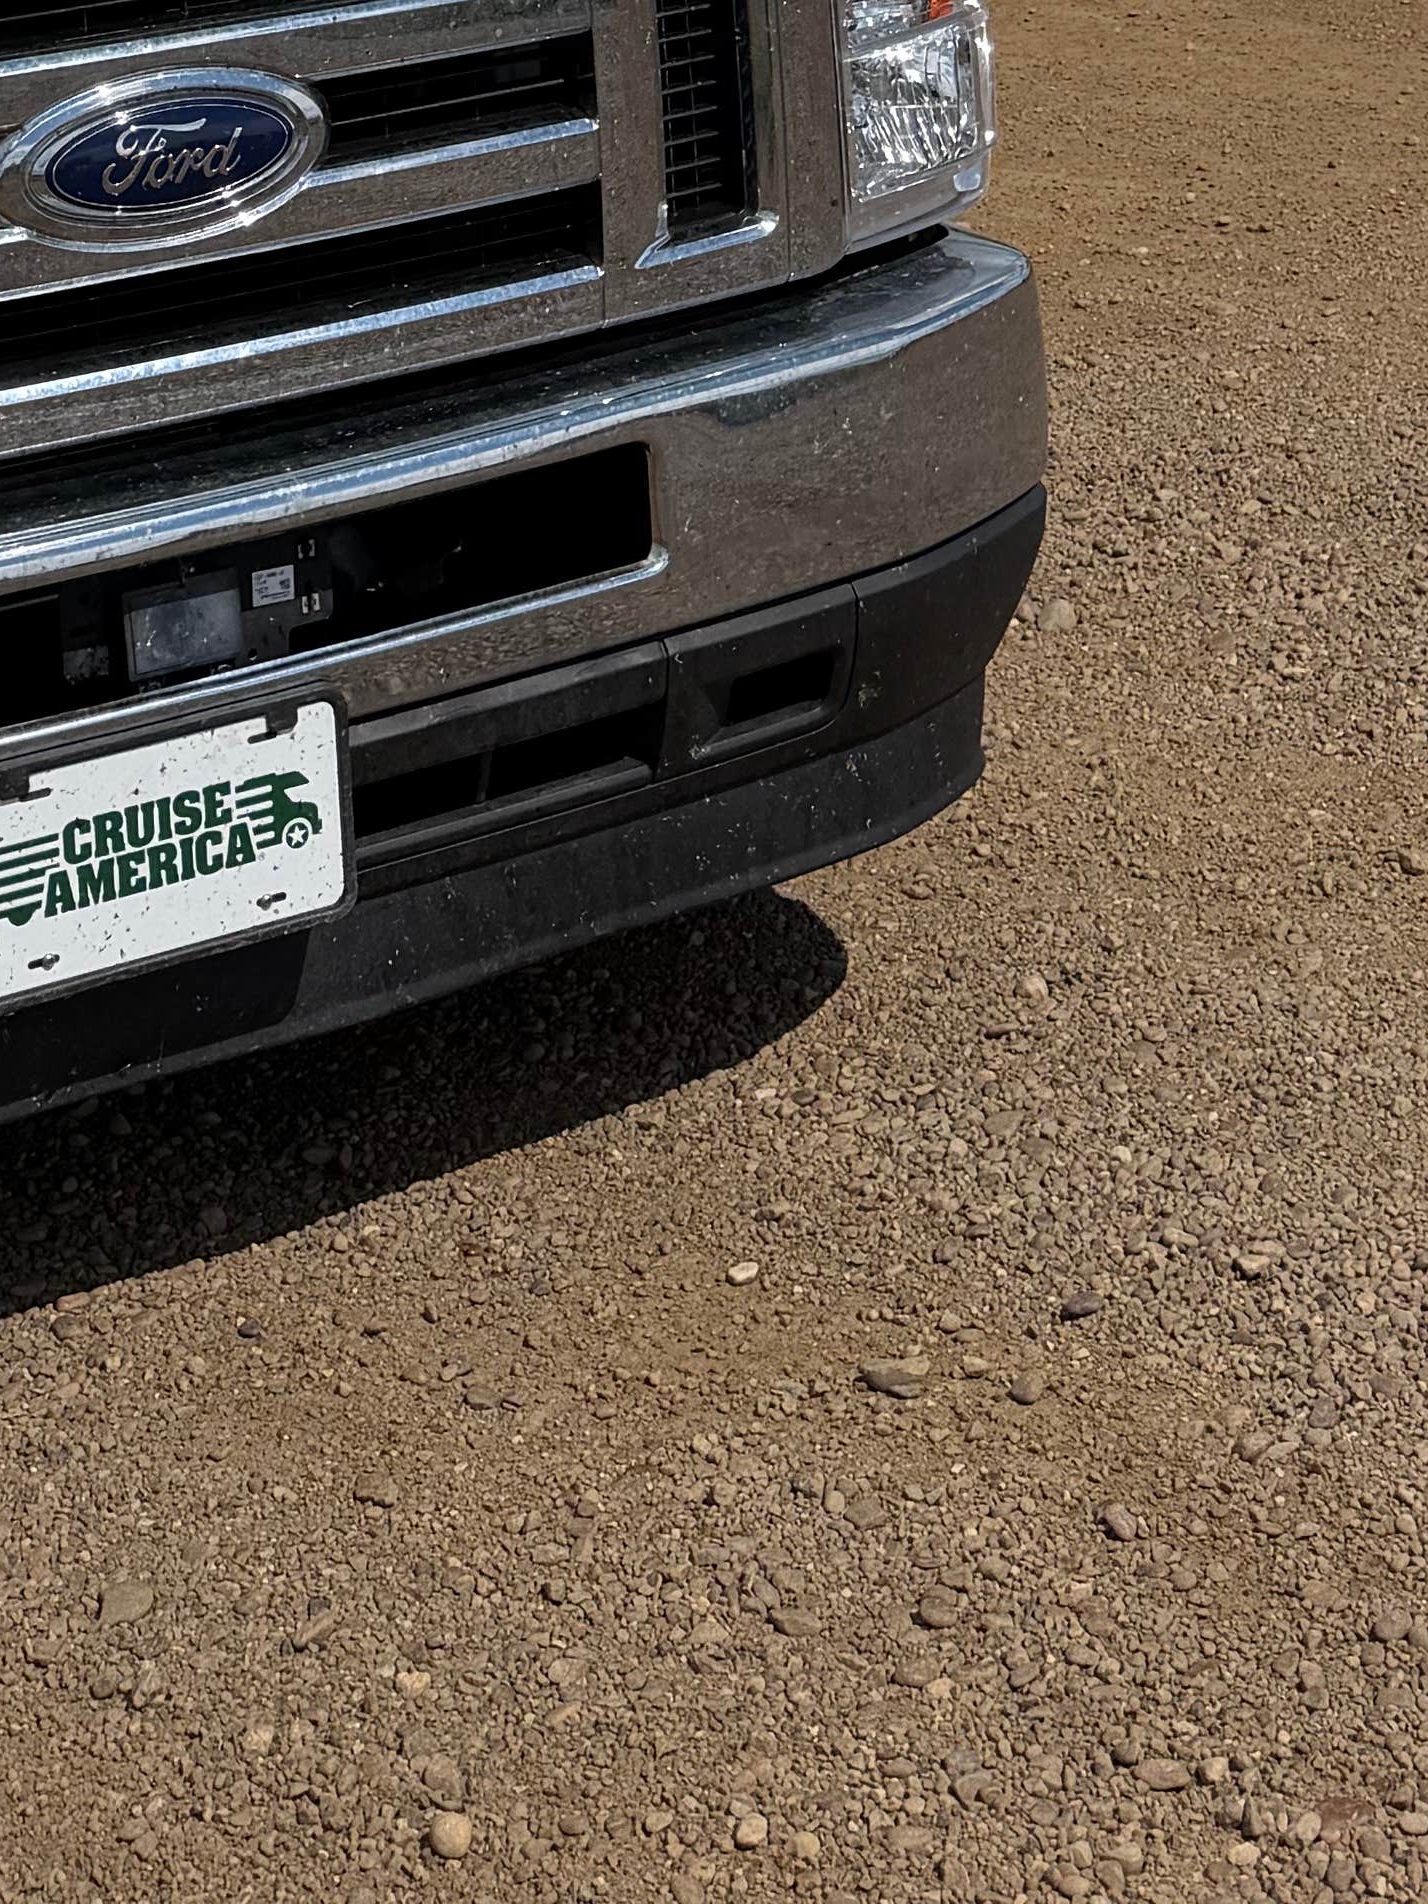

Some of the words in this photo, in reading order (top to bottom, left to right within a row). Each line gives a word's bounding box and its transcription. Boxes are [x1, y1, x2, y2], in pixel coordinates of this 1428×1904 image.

[101, 117, 244, 196] Ford
[61, 780, 233, 863] CRUISE
[43, 821, 257, 918] AMERICA
